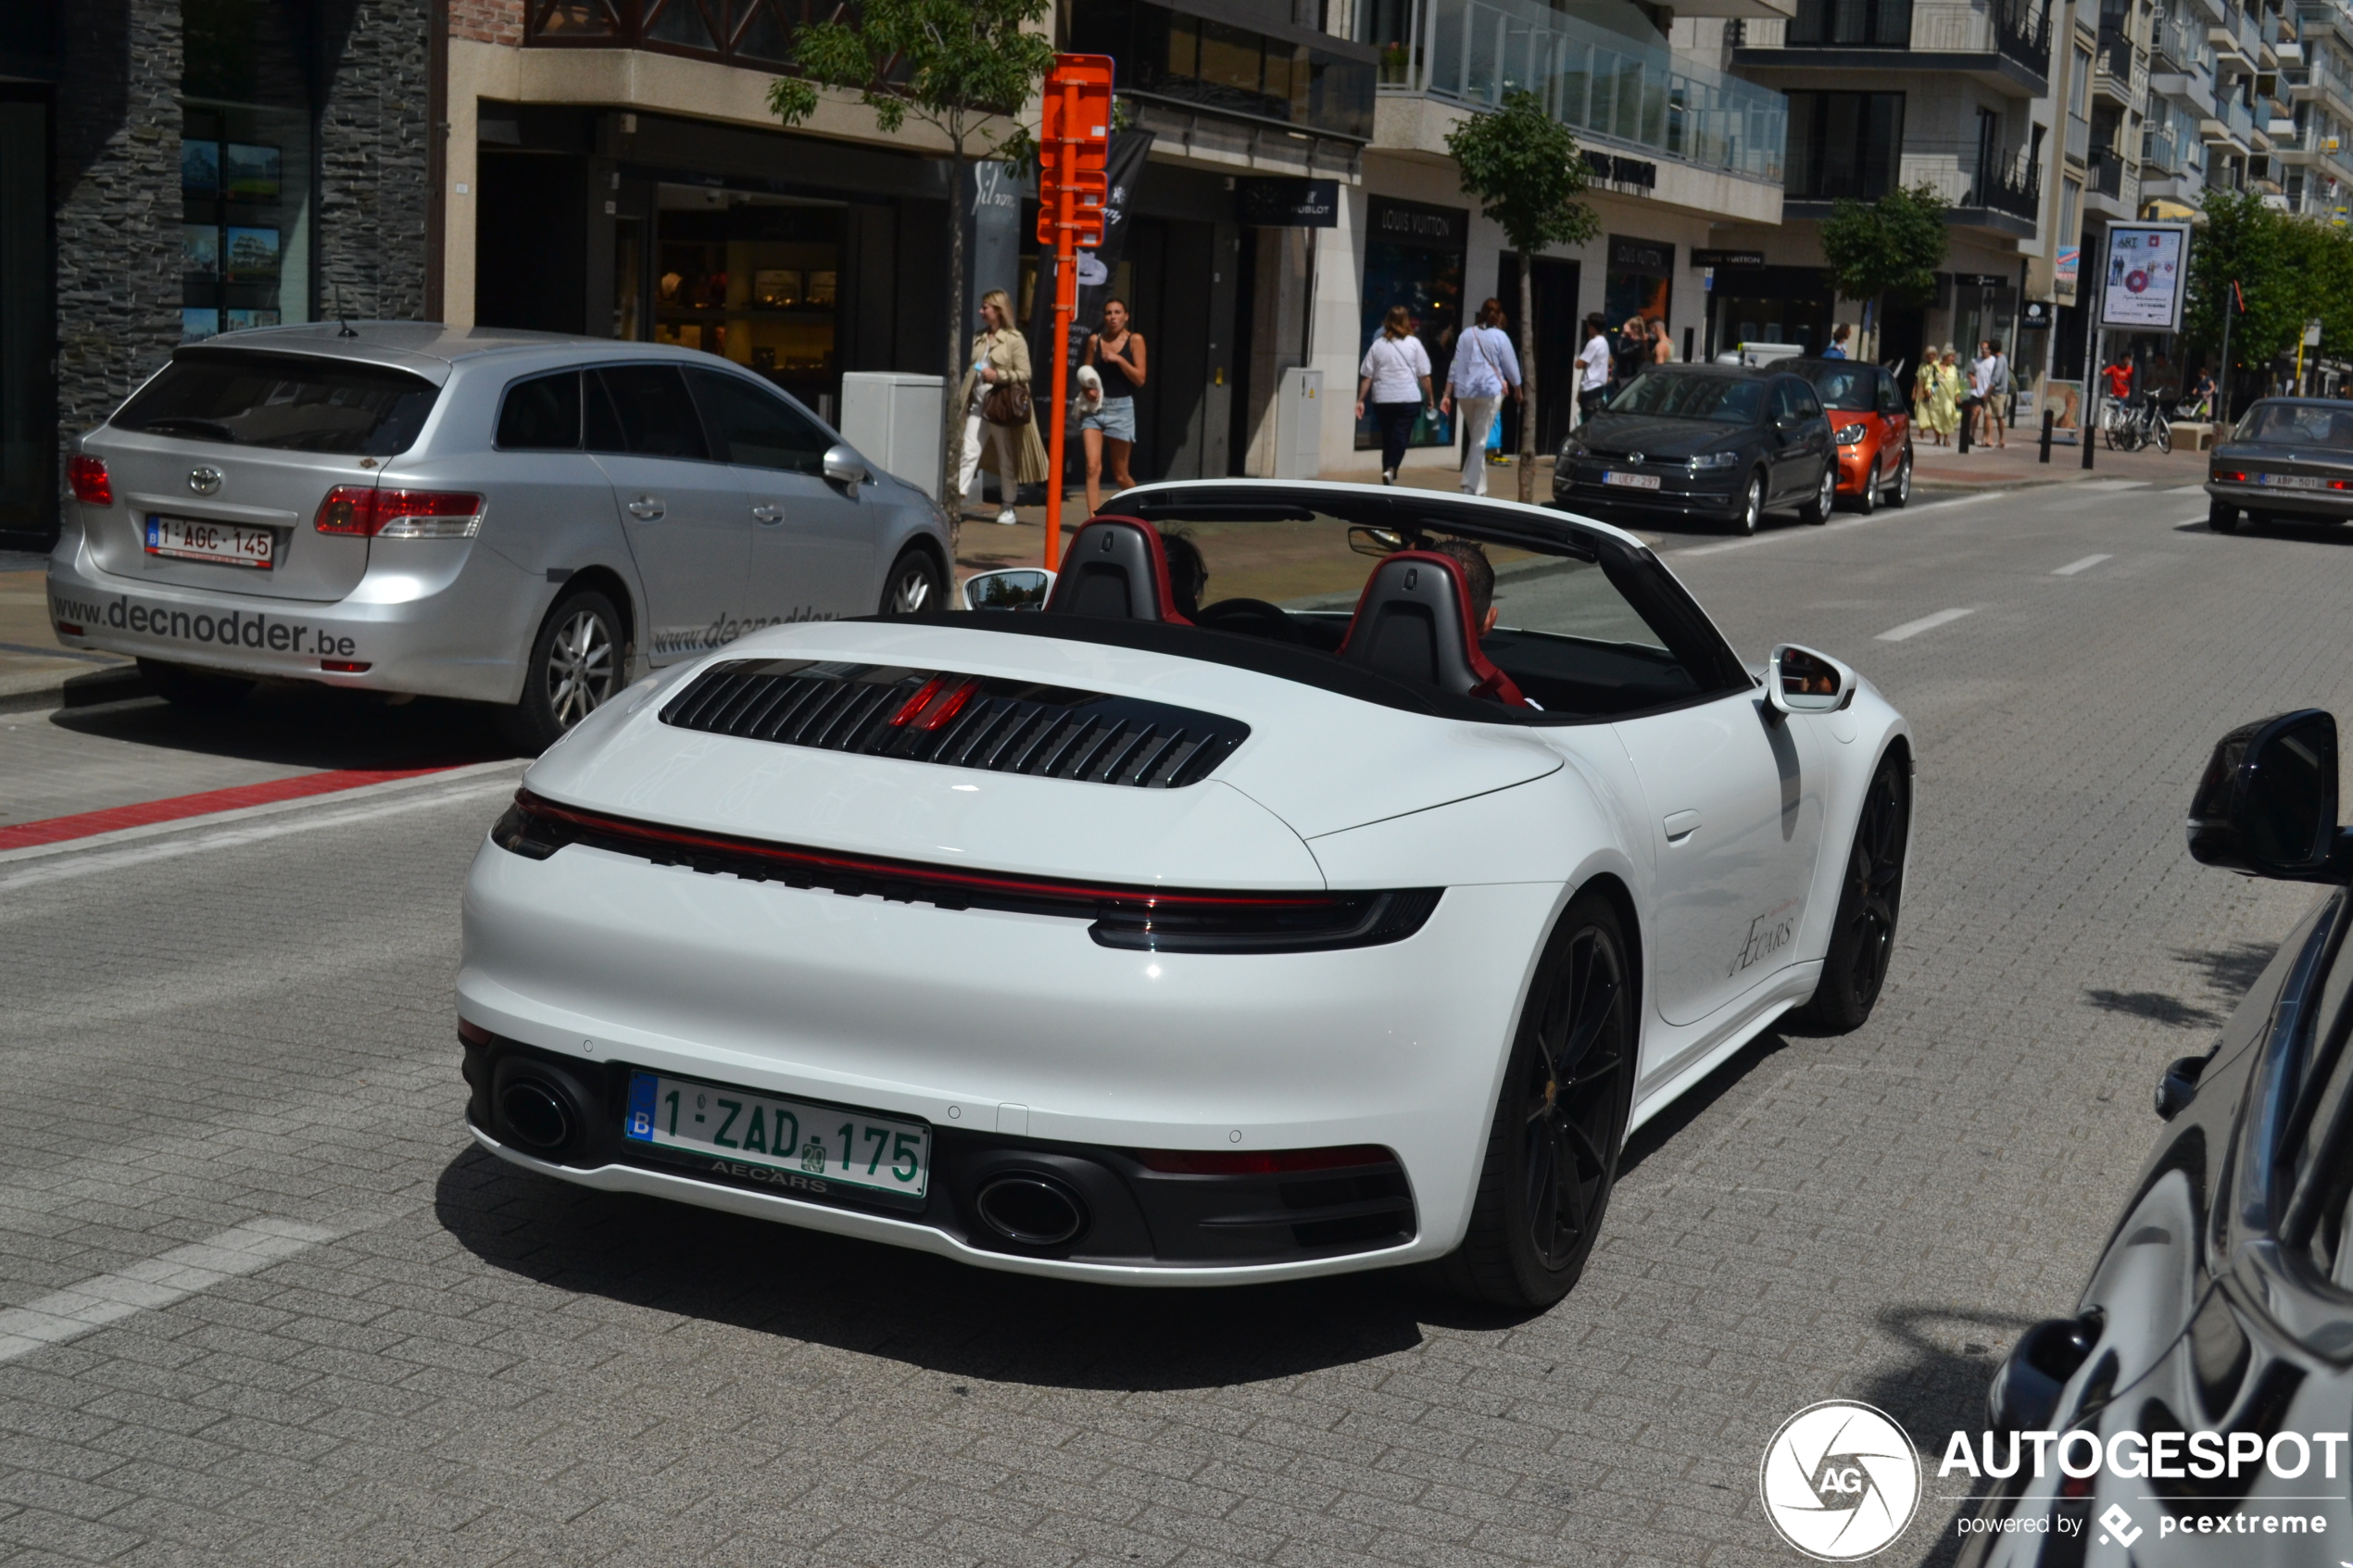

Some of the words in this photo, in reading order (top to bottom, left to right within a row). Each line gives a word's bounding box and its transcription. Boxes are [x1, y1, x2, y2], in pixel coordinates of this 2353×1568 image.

[1290, 205, 1329, 215] HUBLOT
[1382, 208, 1409, 232] LOUIS
[1412, 213, 1450, 237] VUITTON
[1726, 256, 1760, 264] VUITTON
[149, 533, 157, 545] B
[54, 595, 356, 657] www.decnodder.be
[634, 1111, 650, 1135] B
[711, 1160, 828, 1194] AECARS
